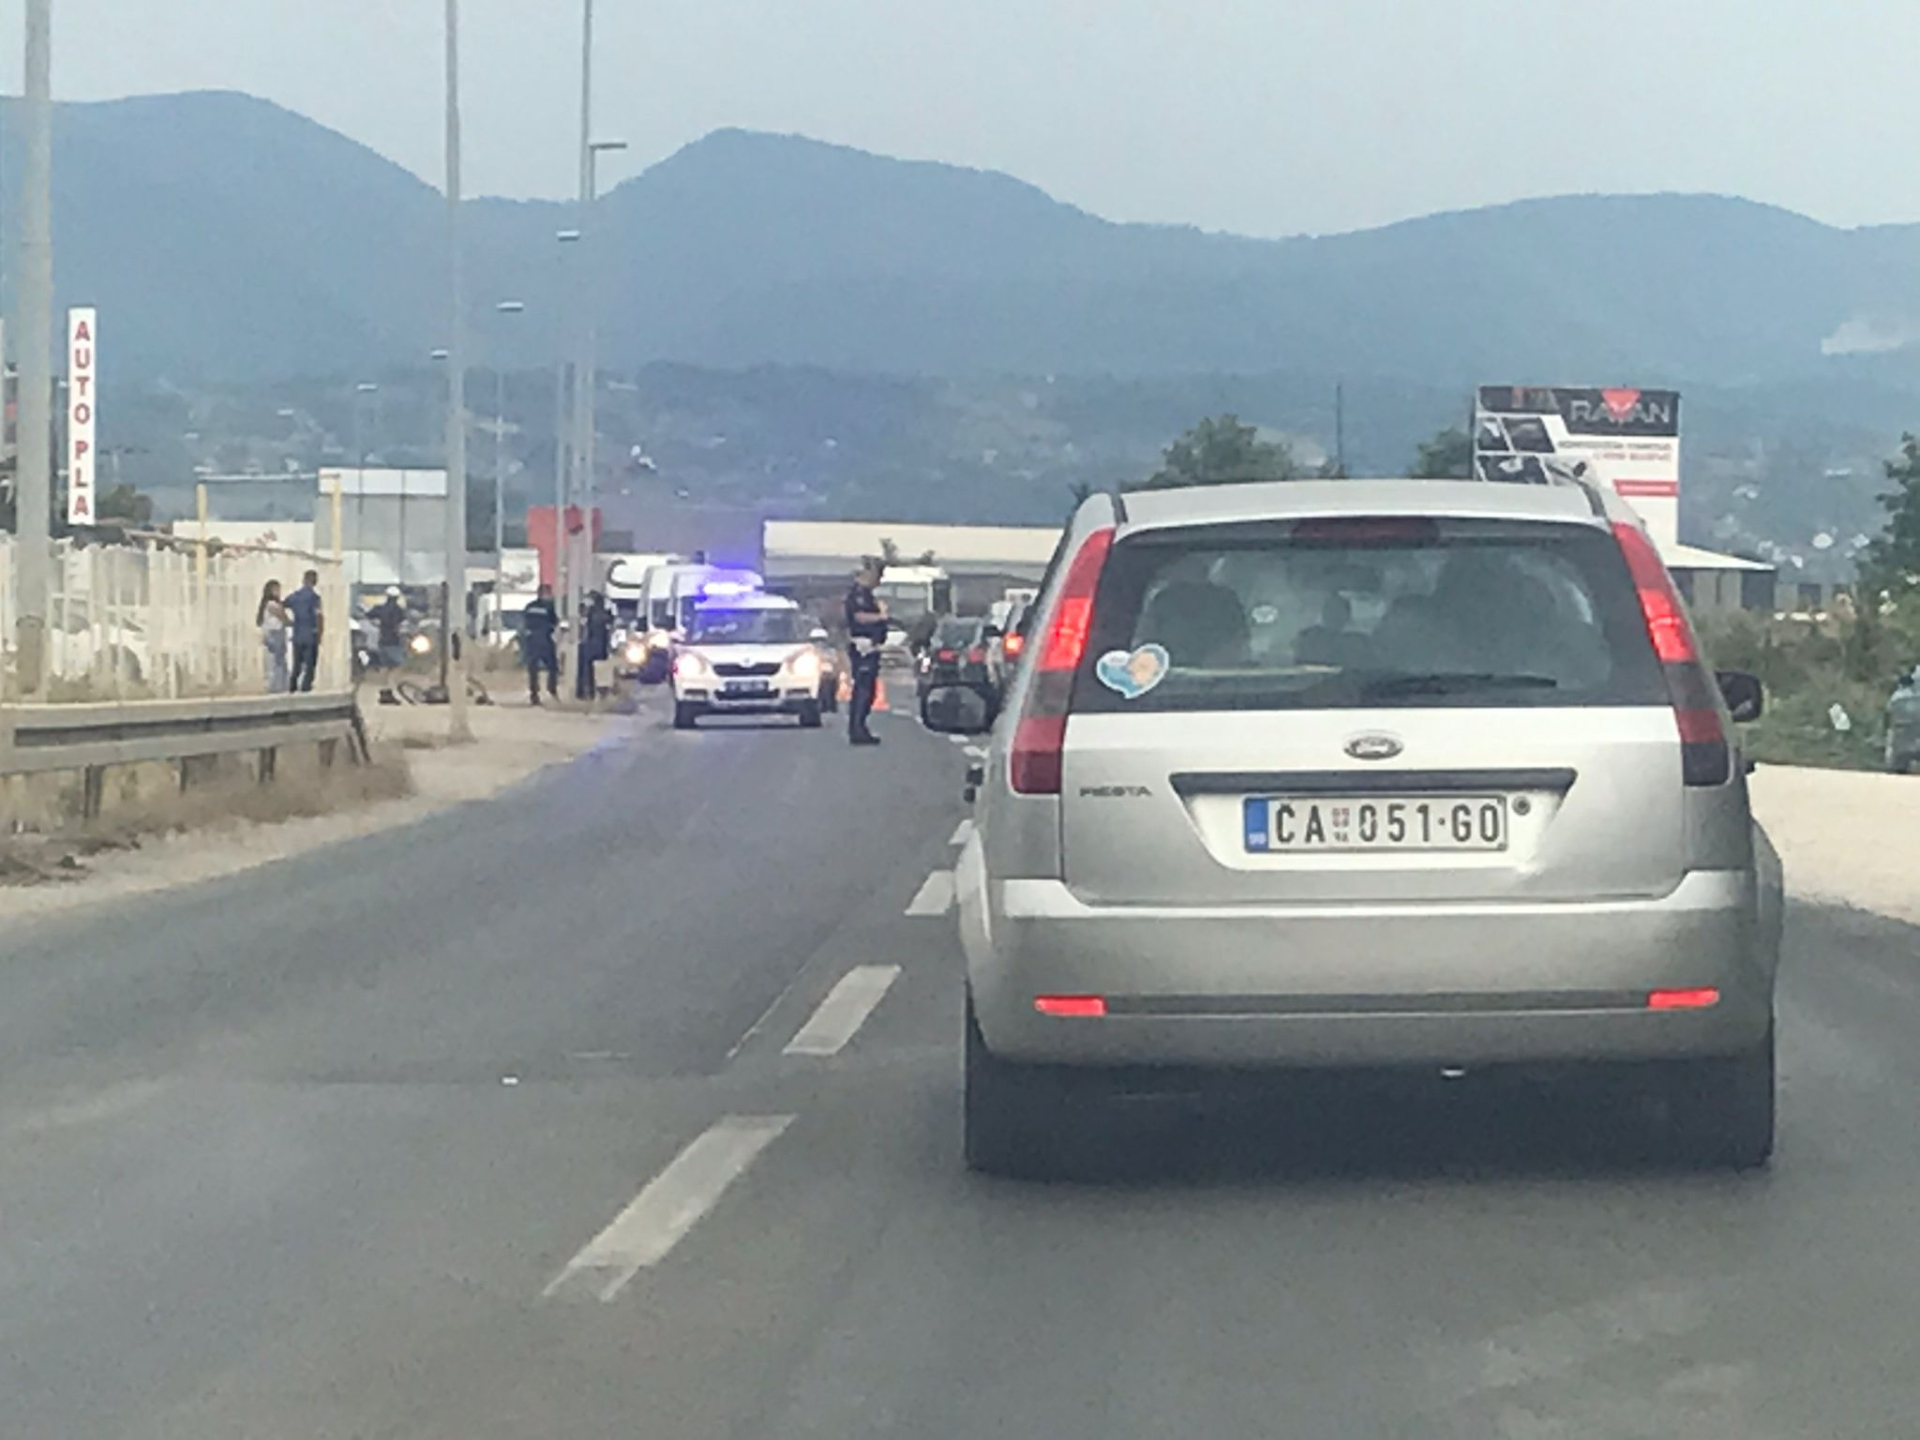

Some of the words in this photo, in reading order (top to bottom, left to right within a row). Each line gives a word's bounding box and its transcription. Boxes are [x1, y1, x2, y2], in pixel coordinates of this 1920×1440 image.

[74, 320, 90, 424] AUTO
[74, 440, 89, 516] PLA
[1079, 785, 1153, 797] FIESTA
